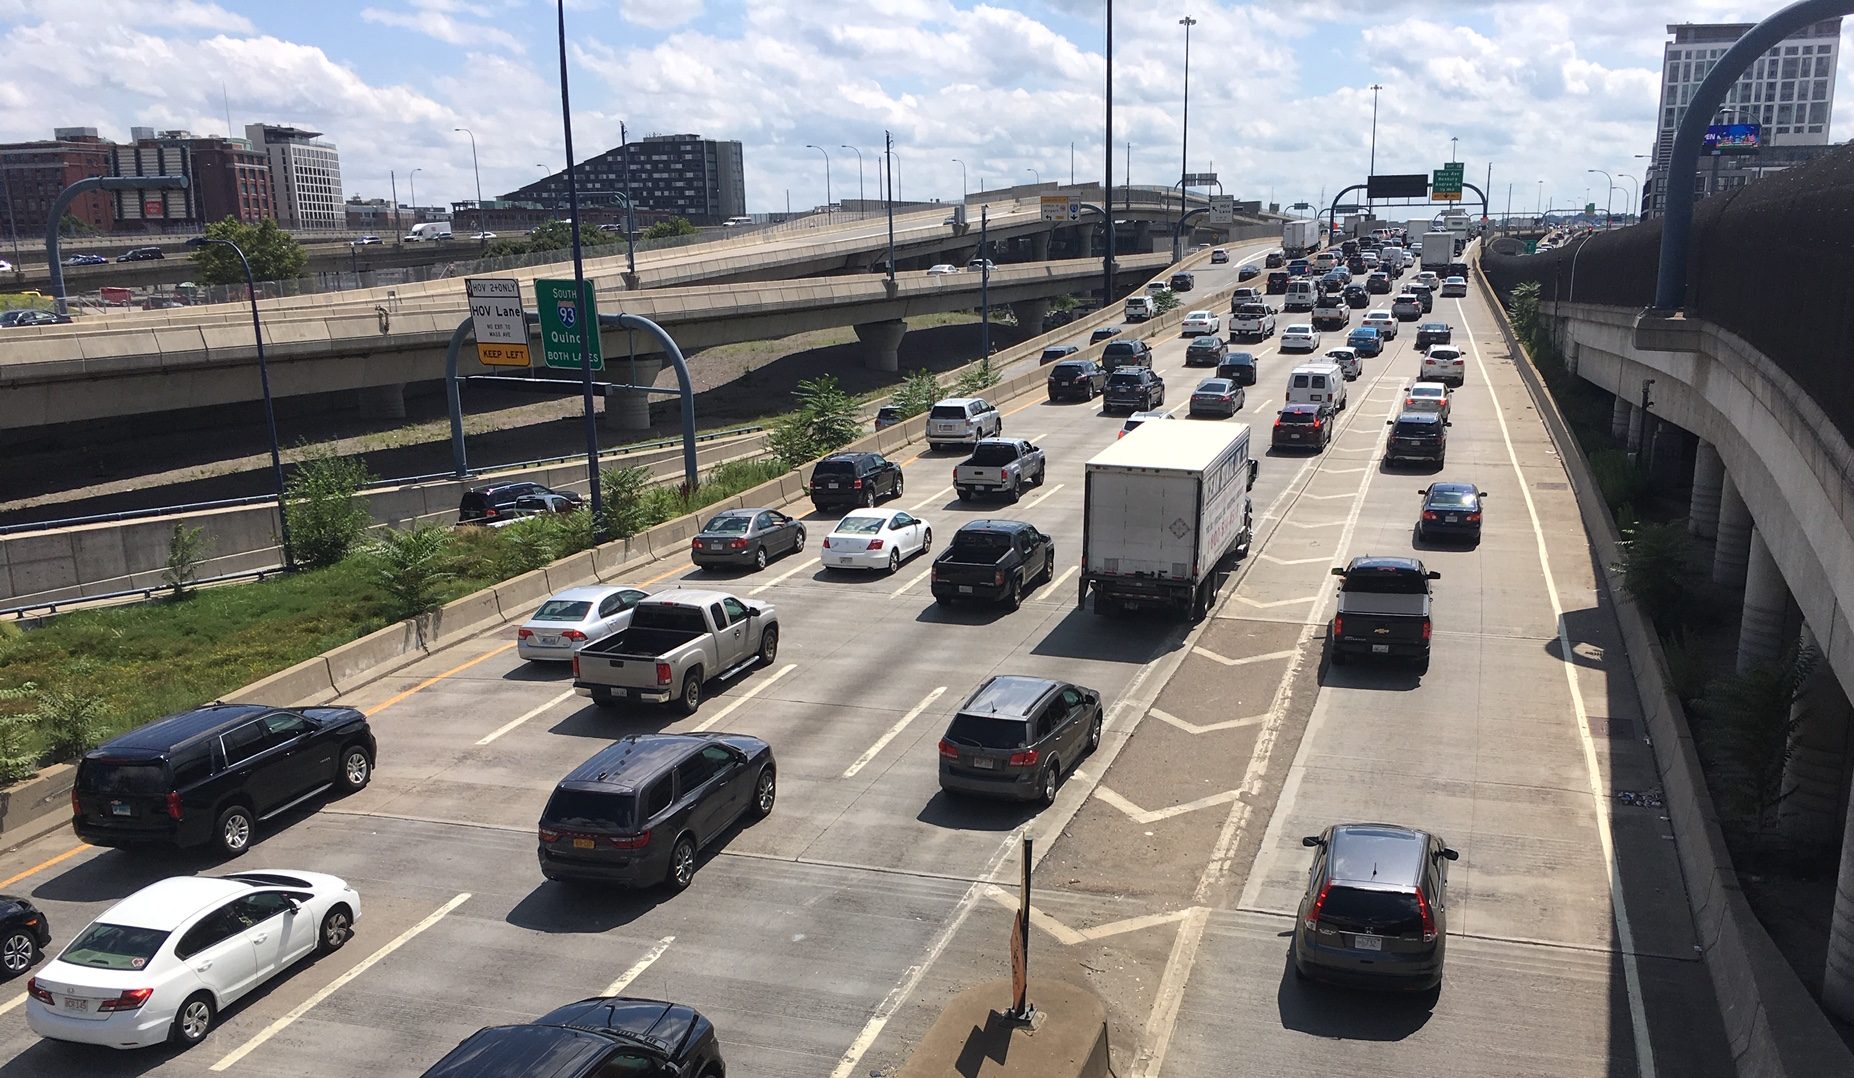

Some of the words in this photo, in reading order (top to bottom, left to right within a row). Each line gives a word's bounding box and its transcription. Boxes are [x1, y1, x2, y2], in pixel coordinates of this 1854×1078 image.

[472, 283, 486, 292] HOV
[552, 288, 577, 298] SOUTH
[472, 305, 491, 316] HOV
[496, 305, 520, 317] Lane
[560, 308, 575, 322] 93
[483, 350, 502, 358] KEEP
[506, 351, 524, 359] LEFT
[548, 352, 569, 360] BOTH
[572, 353, 599, 362] LAES
